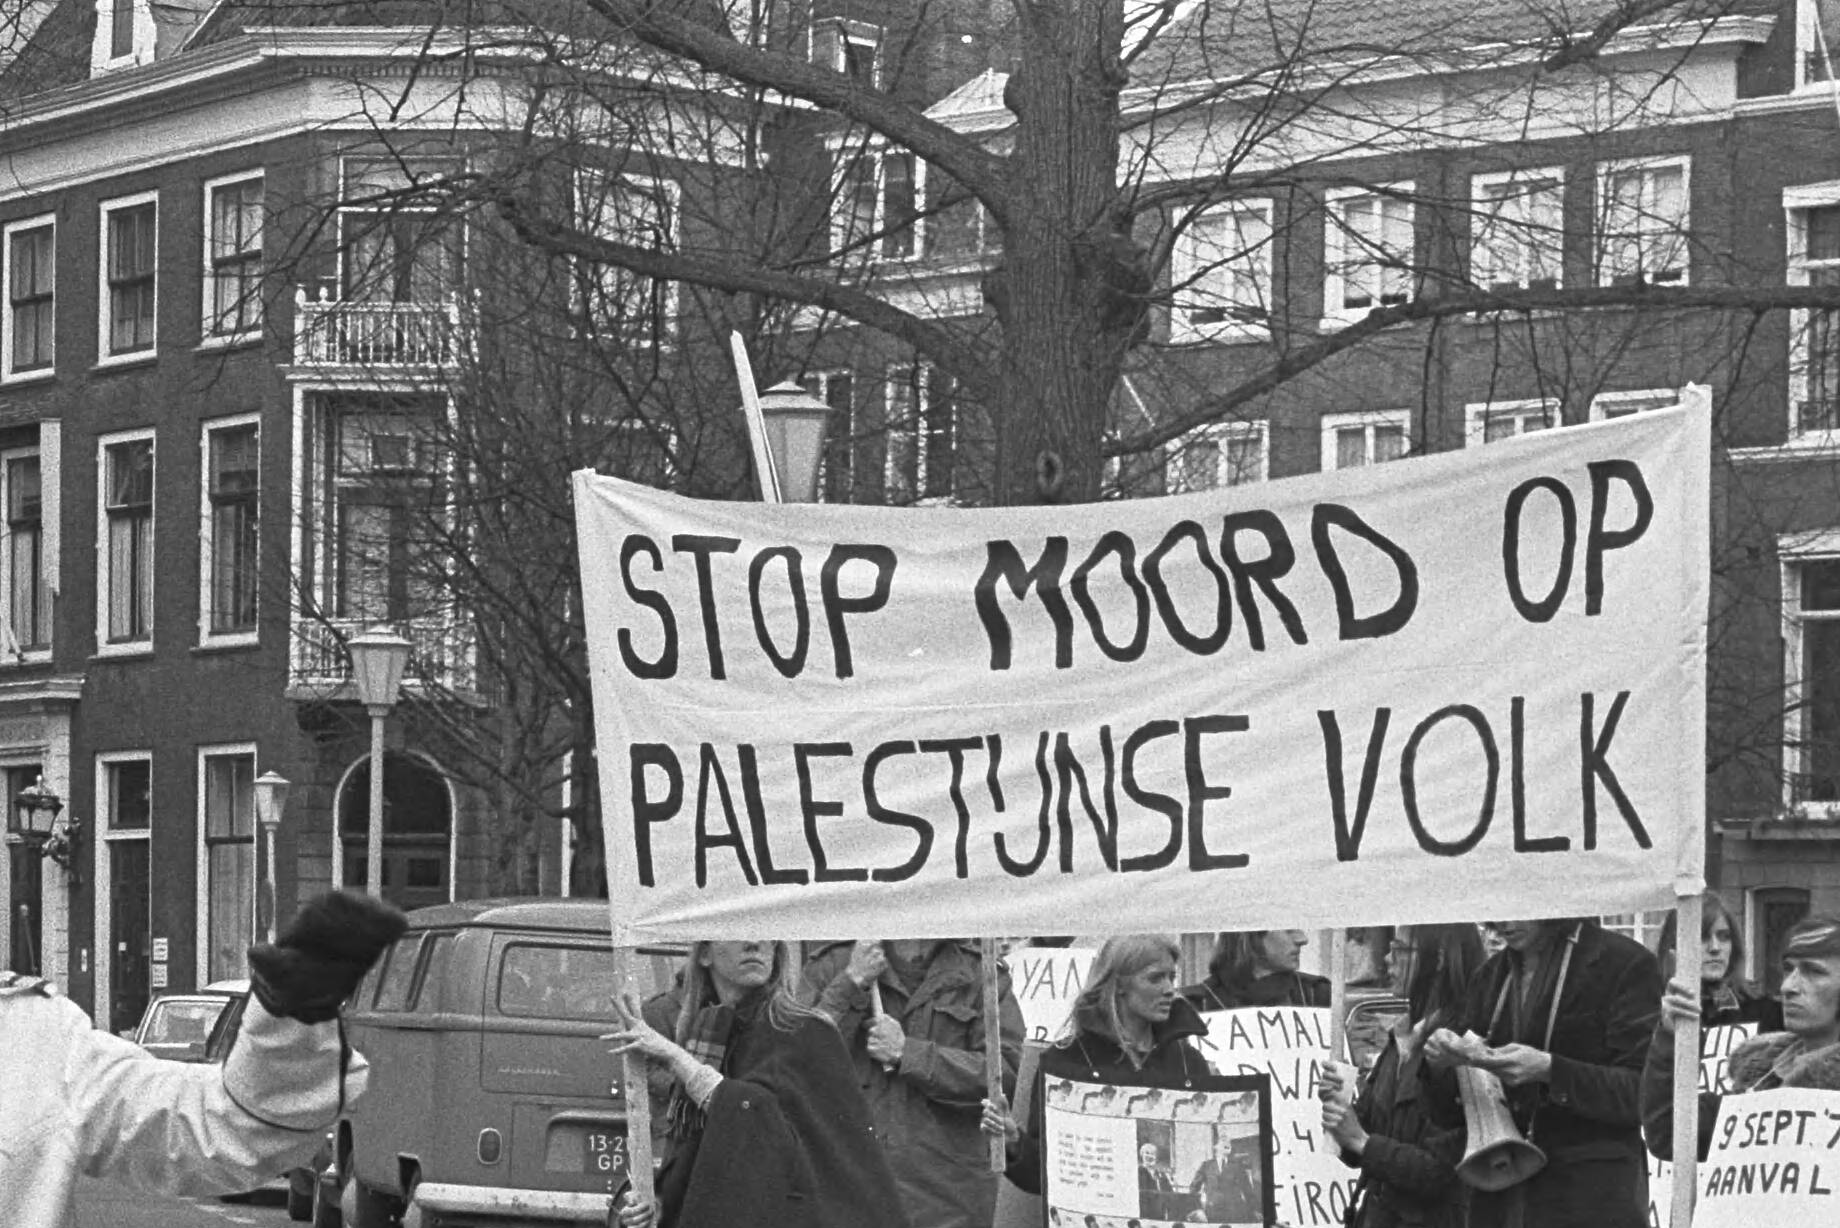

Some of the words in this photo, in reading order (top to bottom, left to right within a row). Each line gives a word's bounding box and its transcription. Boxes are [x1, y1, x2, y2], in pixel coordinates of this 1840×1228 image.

[617, 533, 898, 681] STOP
[973, 502, 1419, 670] MOORD
[1502, 459, 1654, 624] OP
[1316, 690, 1653, 862] VOLK
[589, 1134, 625, 1152] 13-2
[1706, 1162, 1831, 1198] AANVAL
